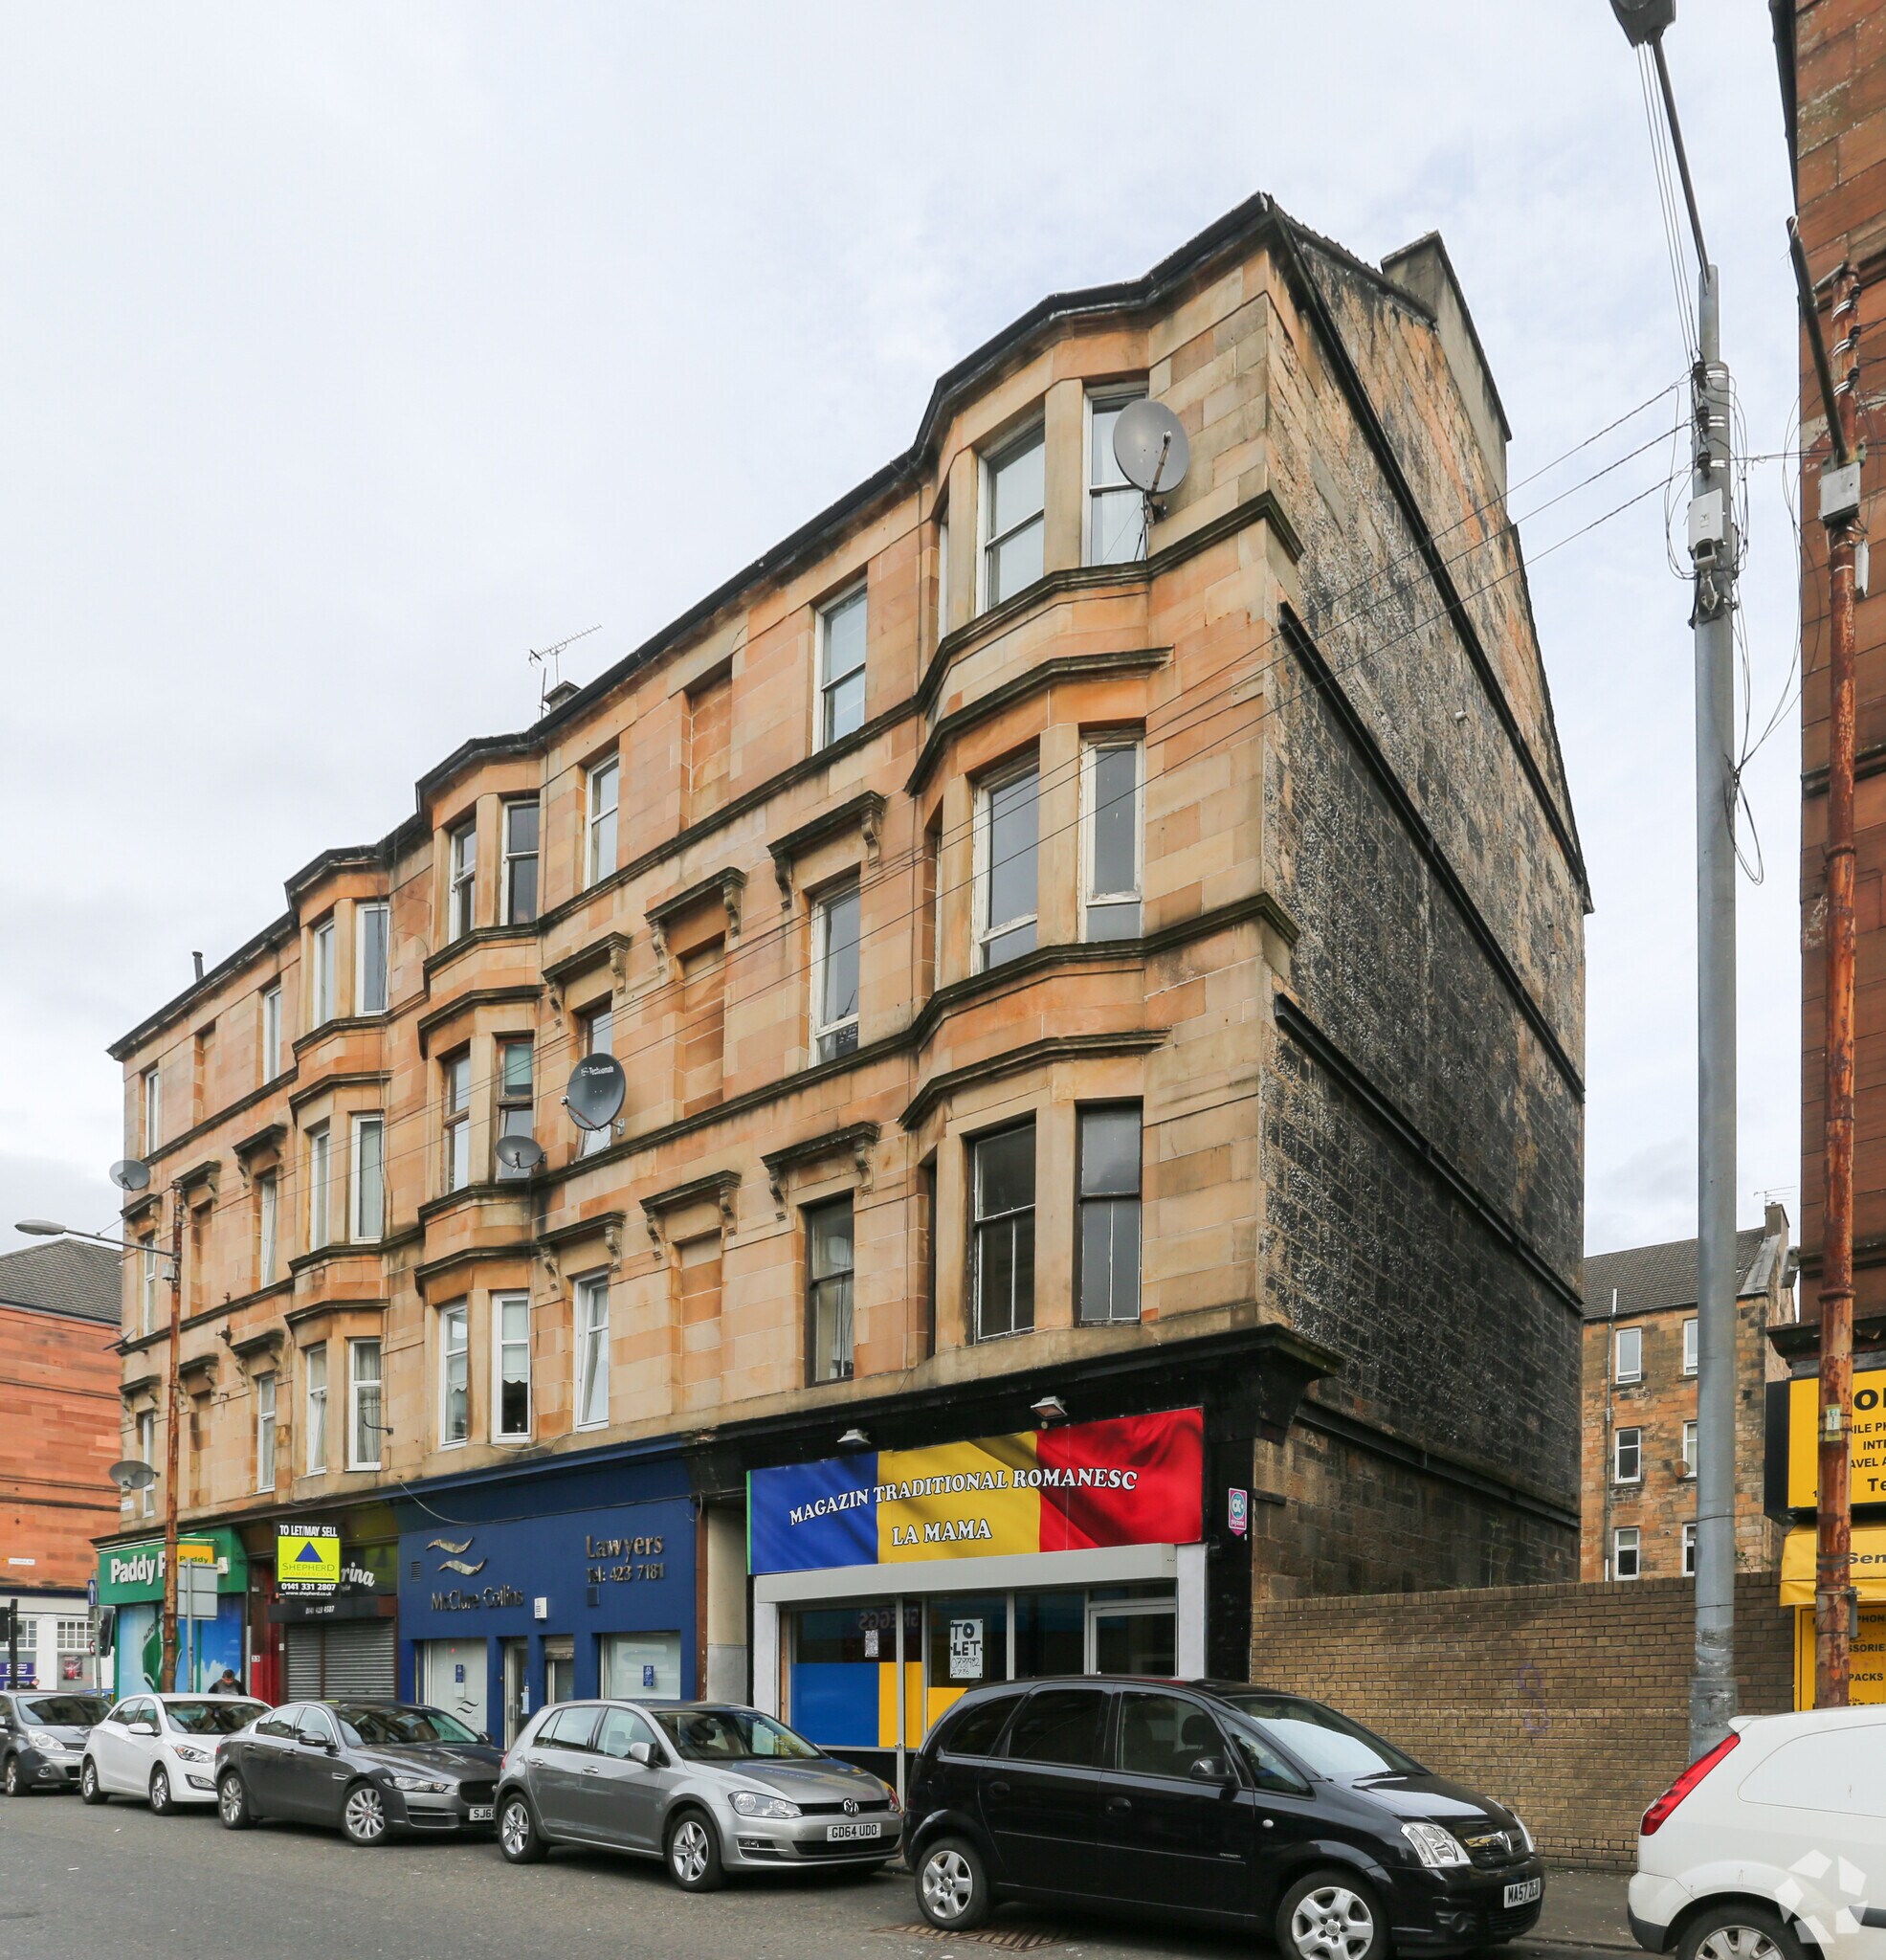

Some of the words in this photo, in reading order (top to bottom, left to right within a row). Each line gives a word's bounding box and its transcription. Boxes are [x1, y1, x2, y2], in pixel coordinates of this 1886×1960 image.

[1852, 1423, 1872, 1434] ILE
[1851, 1458, 1878, 1469] AVEL
[789, 1488, 870, 1526] MAGAZIN
[873, 1470, 1008, 1503] TRADITIONAL
[1012, 1468, 1139, 1490] ROMANESC
[279, 1525, 289, 1536] TO
[291, 1525, 320, 1536] LET/MAY
[322, 1526, 338, 1537] SELL
[892, 1525, 920, 1547] LA
[923, 1518, 992, 1543] MAMA
[586, 1535, 663, 1563] Lawyers
[179, 1555, 209, 1564] Pddy
[282, 1563, 335, 1572] SHEPHERD
[111, 1554, 155, 1585] Paddy
[341, 1561, 376, 1587] rina
[587, 1566, 606, 1583] Tel:
[610, 1565, 632, 1582] 423
[636, 1563, 664, 1580] 7181
[432, 1589, 479, 1611] McClure
[483, 1584, 523, 1608] Collins
[1857, 1615, 1886, 1623] PHON
[949, 1622, 975, 1640] TO
[953, 1640, 981, 1656] LET
[1849, 1673, 1883, 1682] PACKS
[832, 1826, 857, 1838] GD64
